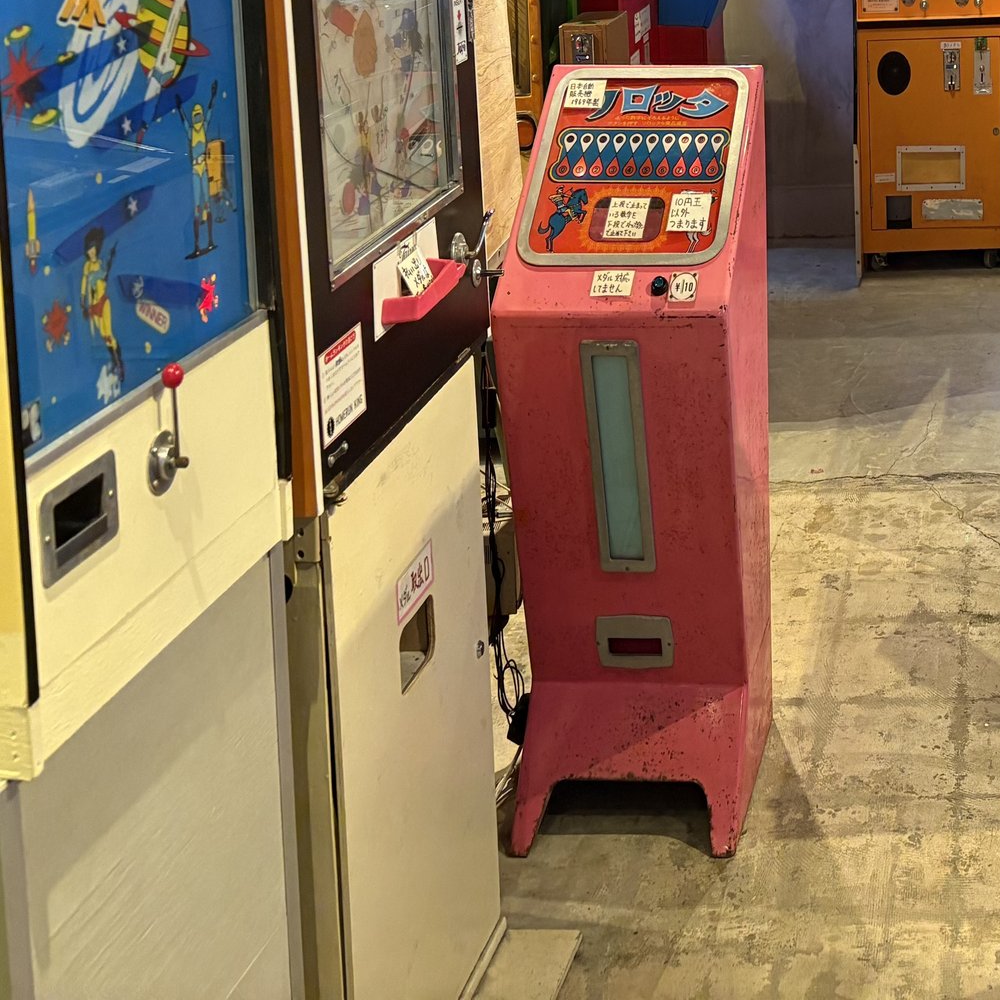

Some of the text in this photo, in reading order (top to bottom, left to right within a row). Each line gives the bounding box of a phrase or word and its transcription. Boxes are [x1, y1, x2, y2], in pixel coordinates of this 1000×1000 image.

[571, 97, 600, 107] 1969年製
[671, 208, 690, 218] 以外
[669, 217, 707, 231] つまります
[593, 284, 623, 294] してません
[139, 304, 169, 330] WINNER
